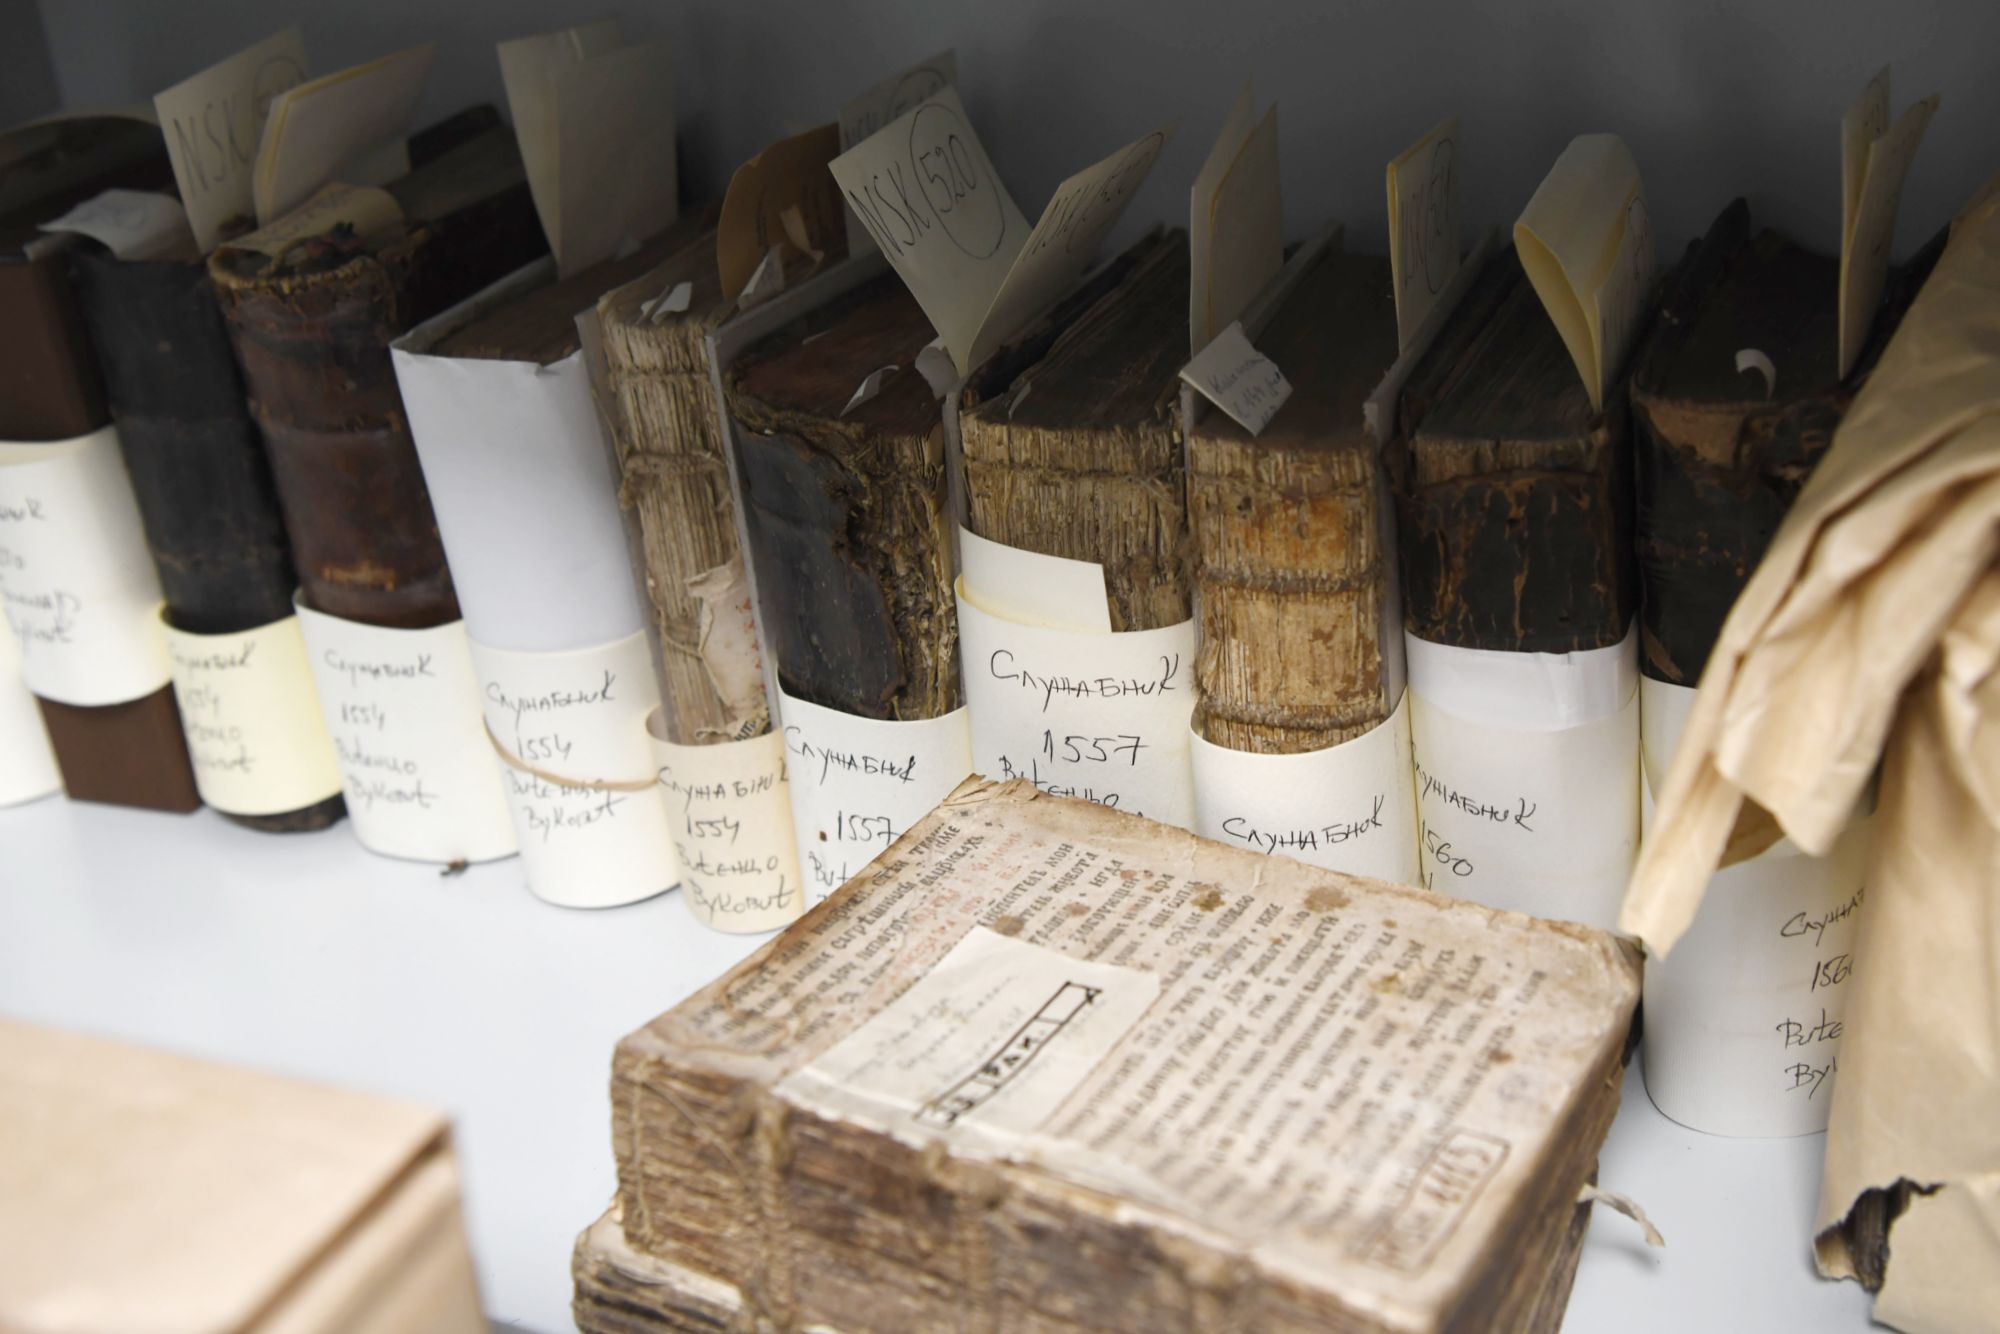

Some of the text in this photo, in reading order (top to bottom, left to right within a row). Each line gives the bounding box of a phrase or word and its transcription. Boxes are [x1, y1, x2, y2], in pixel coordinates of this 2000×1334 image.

[849, 133, 977, 263] NSK 520
[516, 733, 573, 762] 1554
[1043, 728, 1151, 767] 1557
[686, 816, 740, 847] 1554
[837, 810, 901, 846] 1557
[1421, 819, 1474, 877] 1560
[1811, 953, 1854, 993] 156
